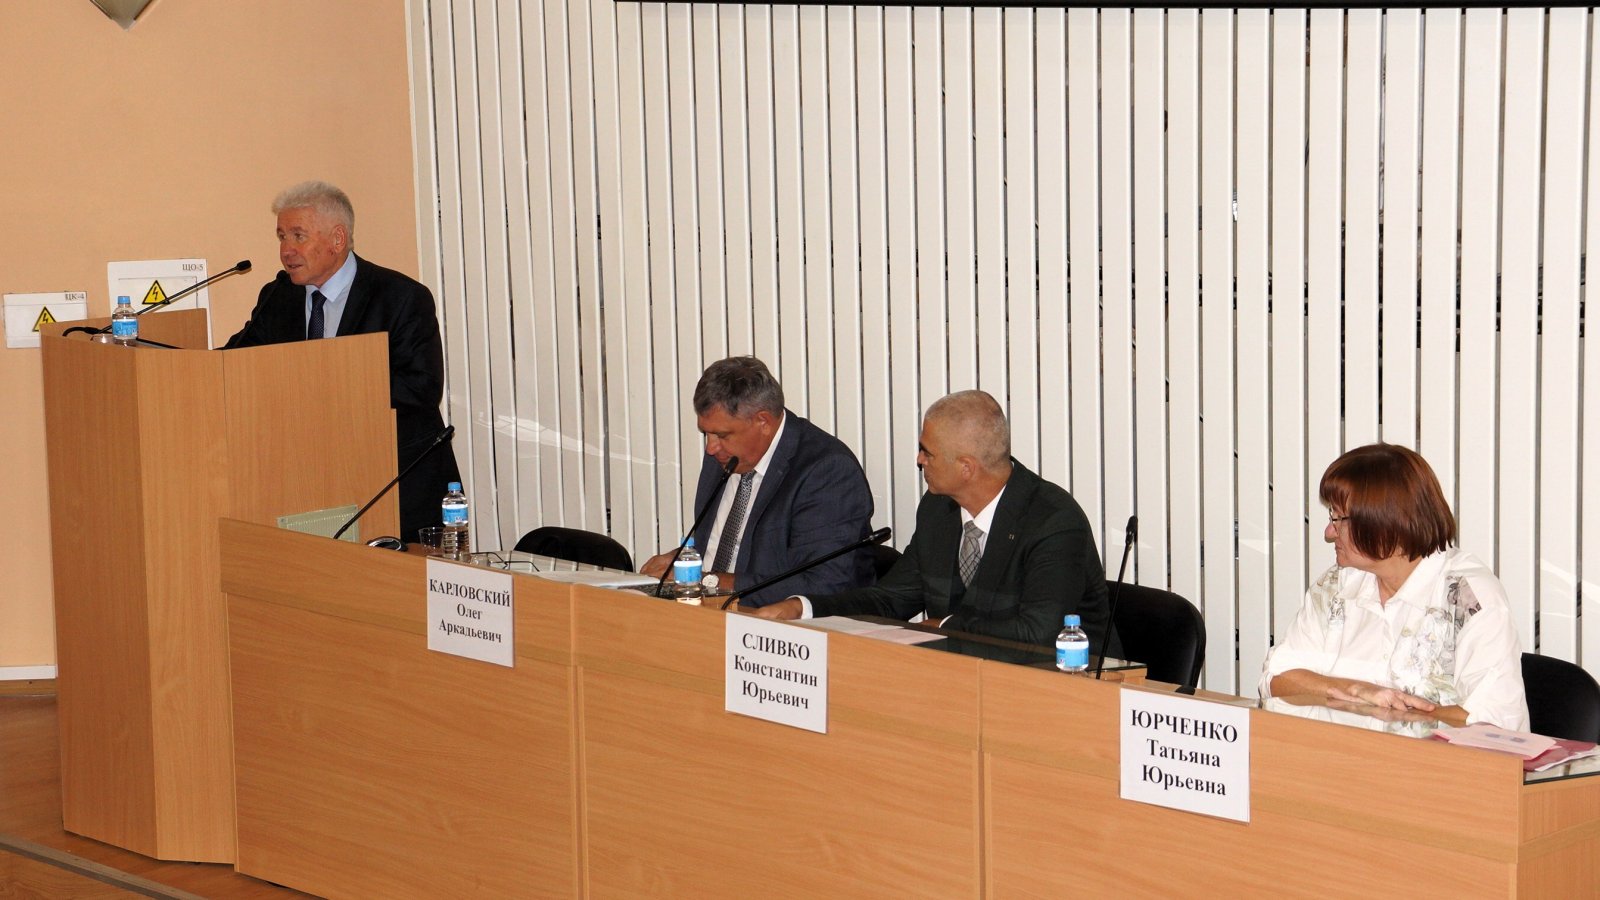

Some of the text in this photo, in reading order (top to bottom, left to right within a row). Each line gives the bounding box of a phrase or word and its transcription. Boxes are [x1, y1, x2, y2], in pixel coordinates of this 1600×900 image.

[429, 578, 511, 607] КАРЛОВСКИЙ
[457, 603, 483, 620] Олег
[438, 619, 502, 643] Аркадьевич
[742, 632, 810, 661] СЛИВКО
[734, 654, 818, 687] Константин
[742, 680, 809, 709] Юрьевич
[1131, 709, 1238, 743] ЮРЧЕНКО
[1146, 738, 1221, 768] Татьяна
[1142, 764, 1226, 796] Юрьевна
